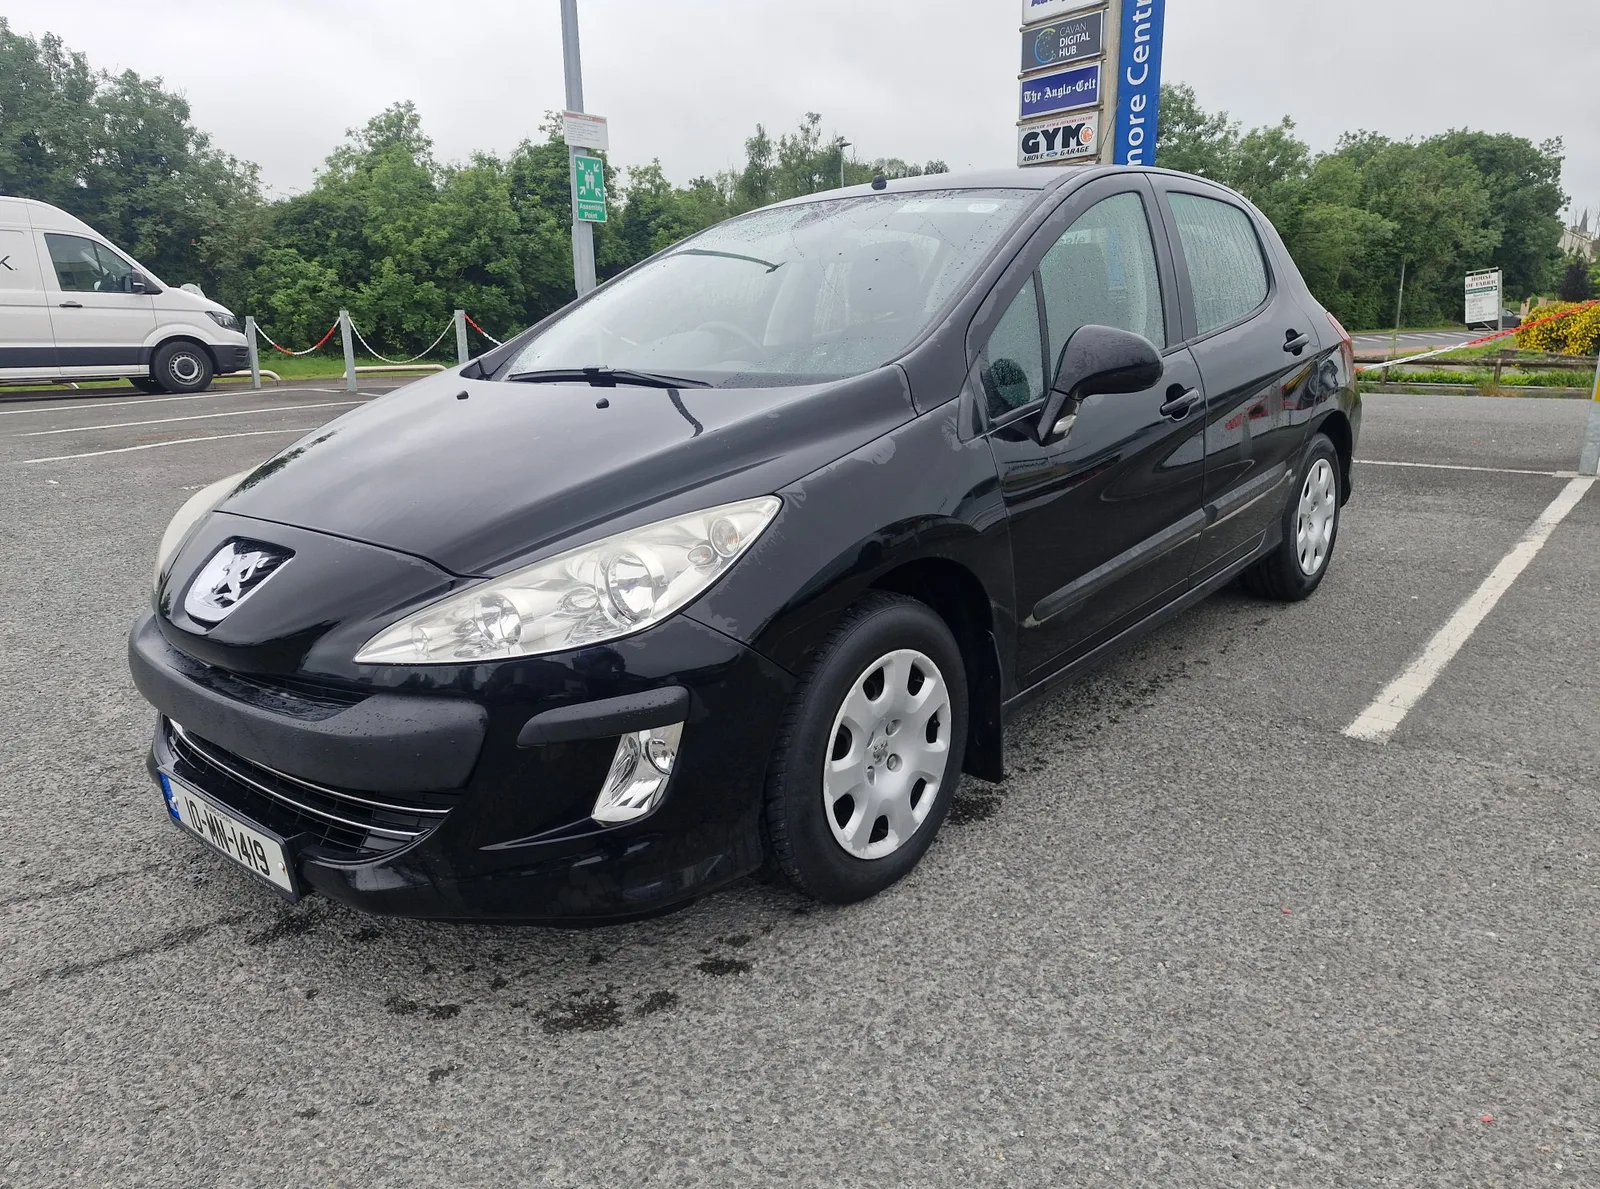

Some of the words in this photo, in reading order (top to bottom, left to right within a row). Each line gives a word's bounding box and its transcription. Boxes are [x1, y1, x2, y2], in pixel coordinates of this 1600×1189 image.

[1059, 22, 1087, 36] CAVAN
[1059, 32, 1091, 47] DIGITAL
[1058, 46, 1077, 58] HUB
[1023, 89, 1042, 104] The
[1044, 77, 1096, 101] Anglo-Celt
[1021, 122, 1086, 155] GYM
[1022, 153, 1045, 162] ABOVE
[1060, 145, 1090, 156] GARAGE
[579, 203, 603, 212] Assembly
[584, 211, 598, 219] Point
[1475, 279, 1497, 287] FABRIC
[184, 796, 271, 877] 10-MN-1419
